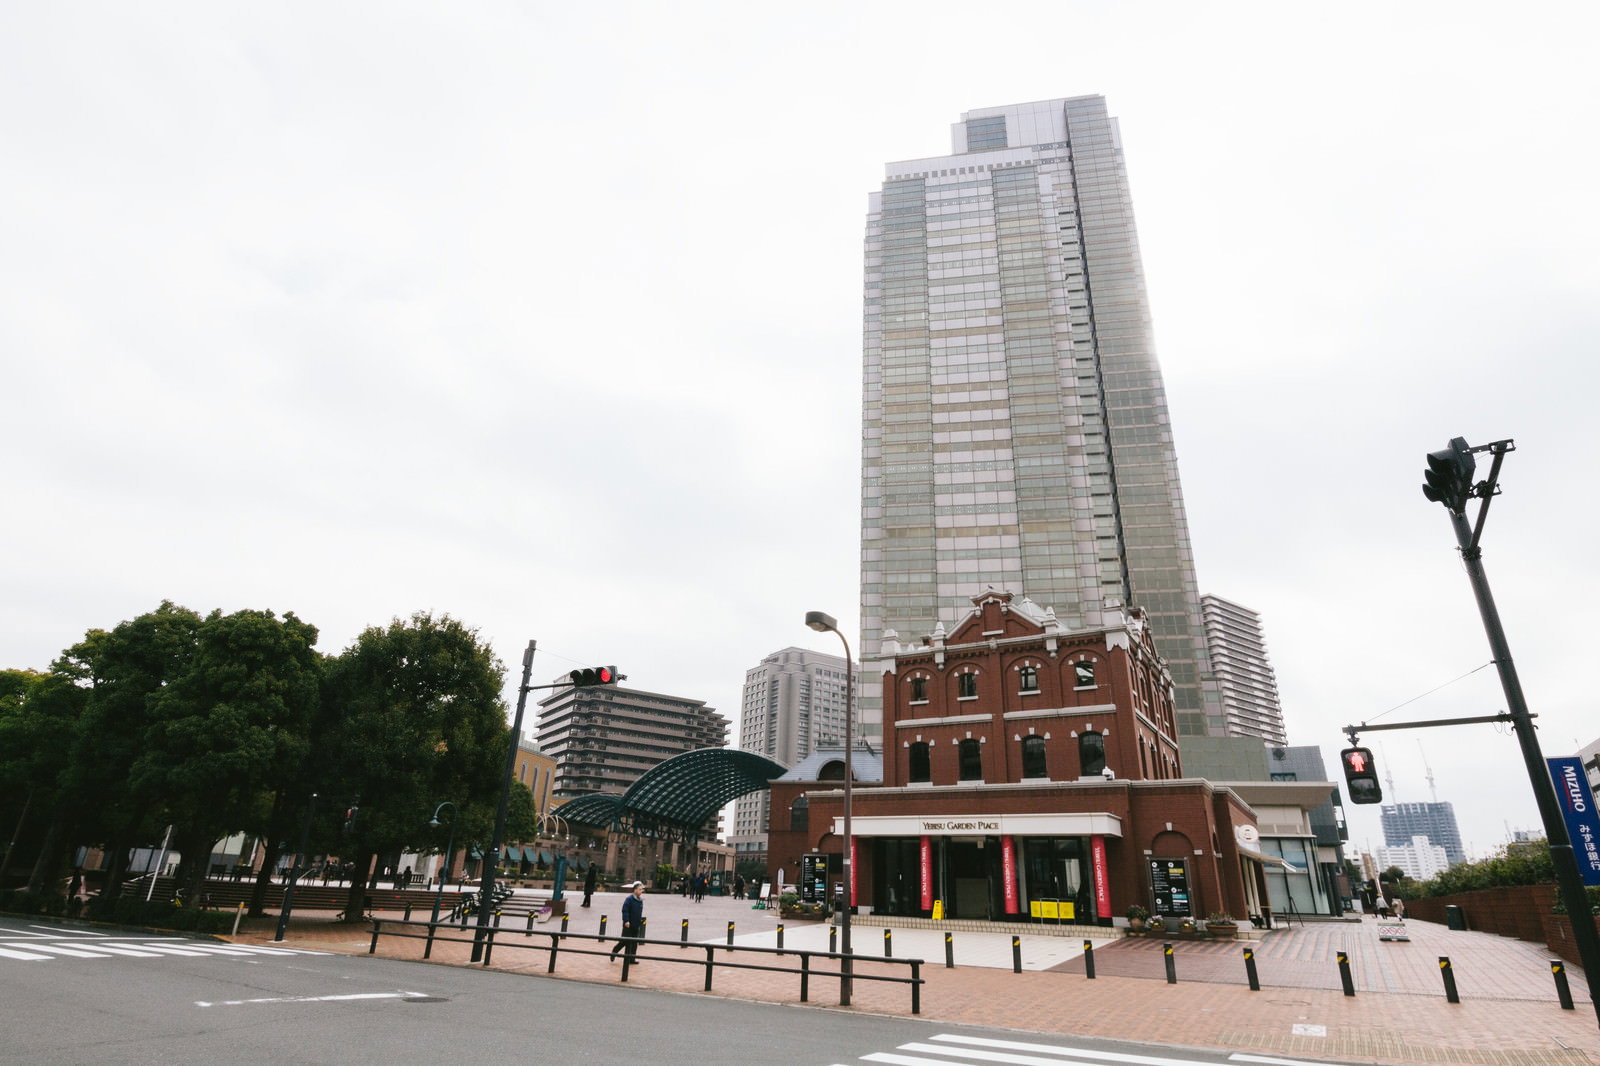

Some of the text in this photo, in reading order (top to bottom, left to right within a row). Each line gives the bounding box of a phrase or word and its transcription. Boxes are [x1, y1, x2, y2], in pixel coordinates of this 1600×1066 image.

[1562, 765, 1586, 813] MIZUHO
[947, 821, 976, 830] GARDEN
[978, 821, 999, 830] PLACE
